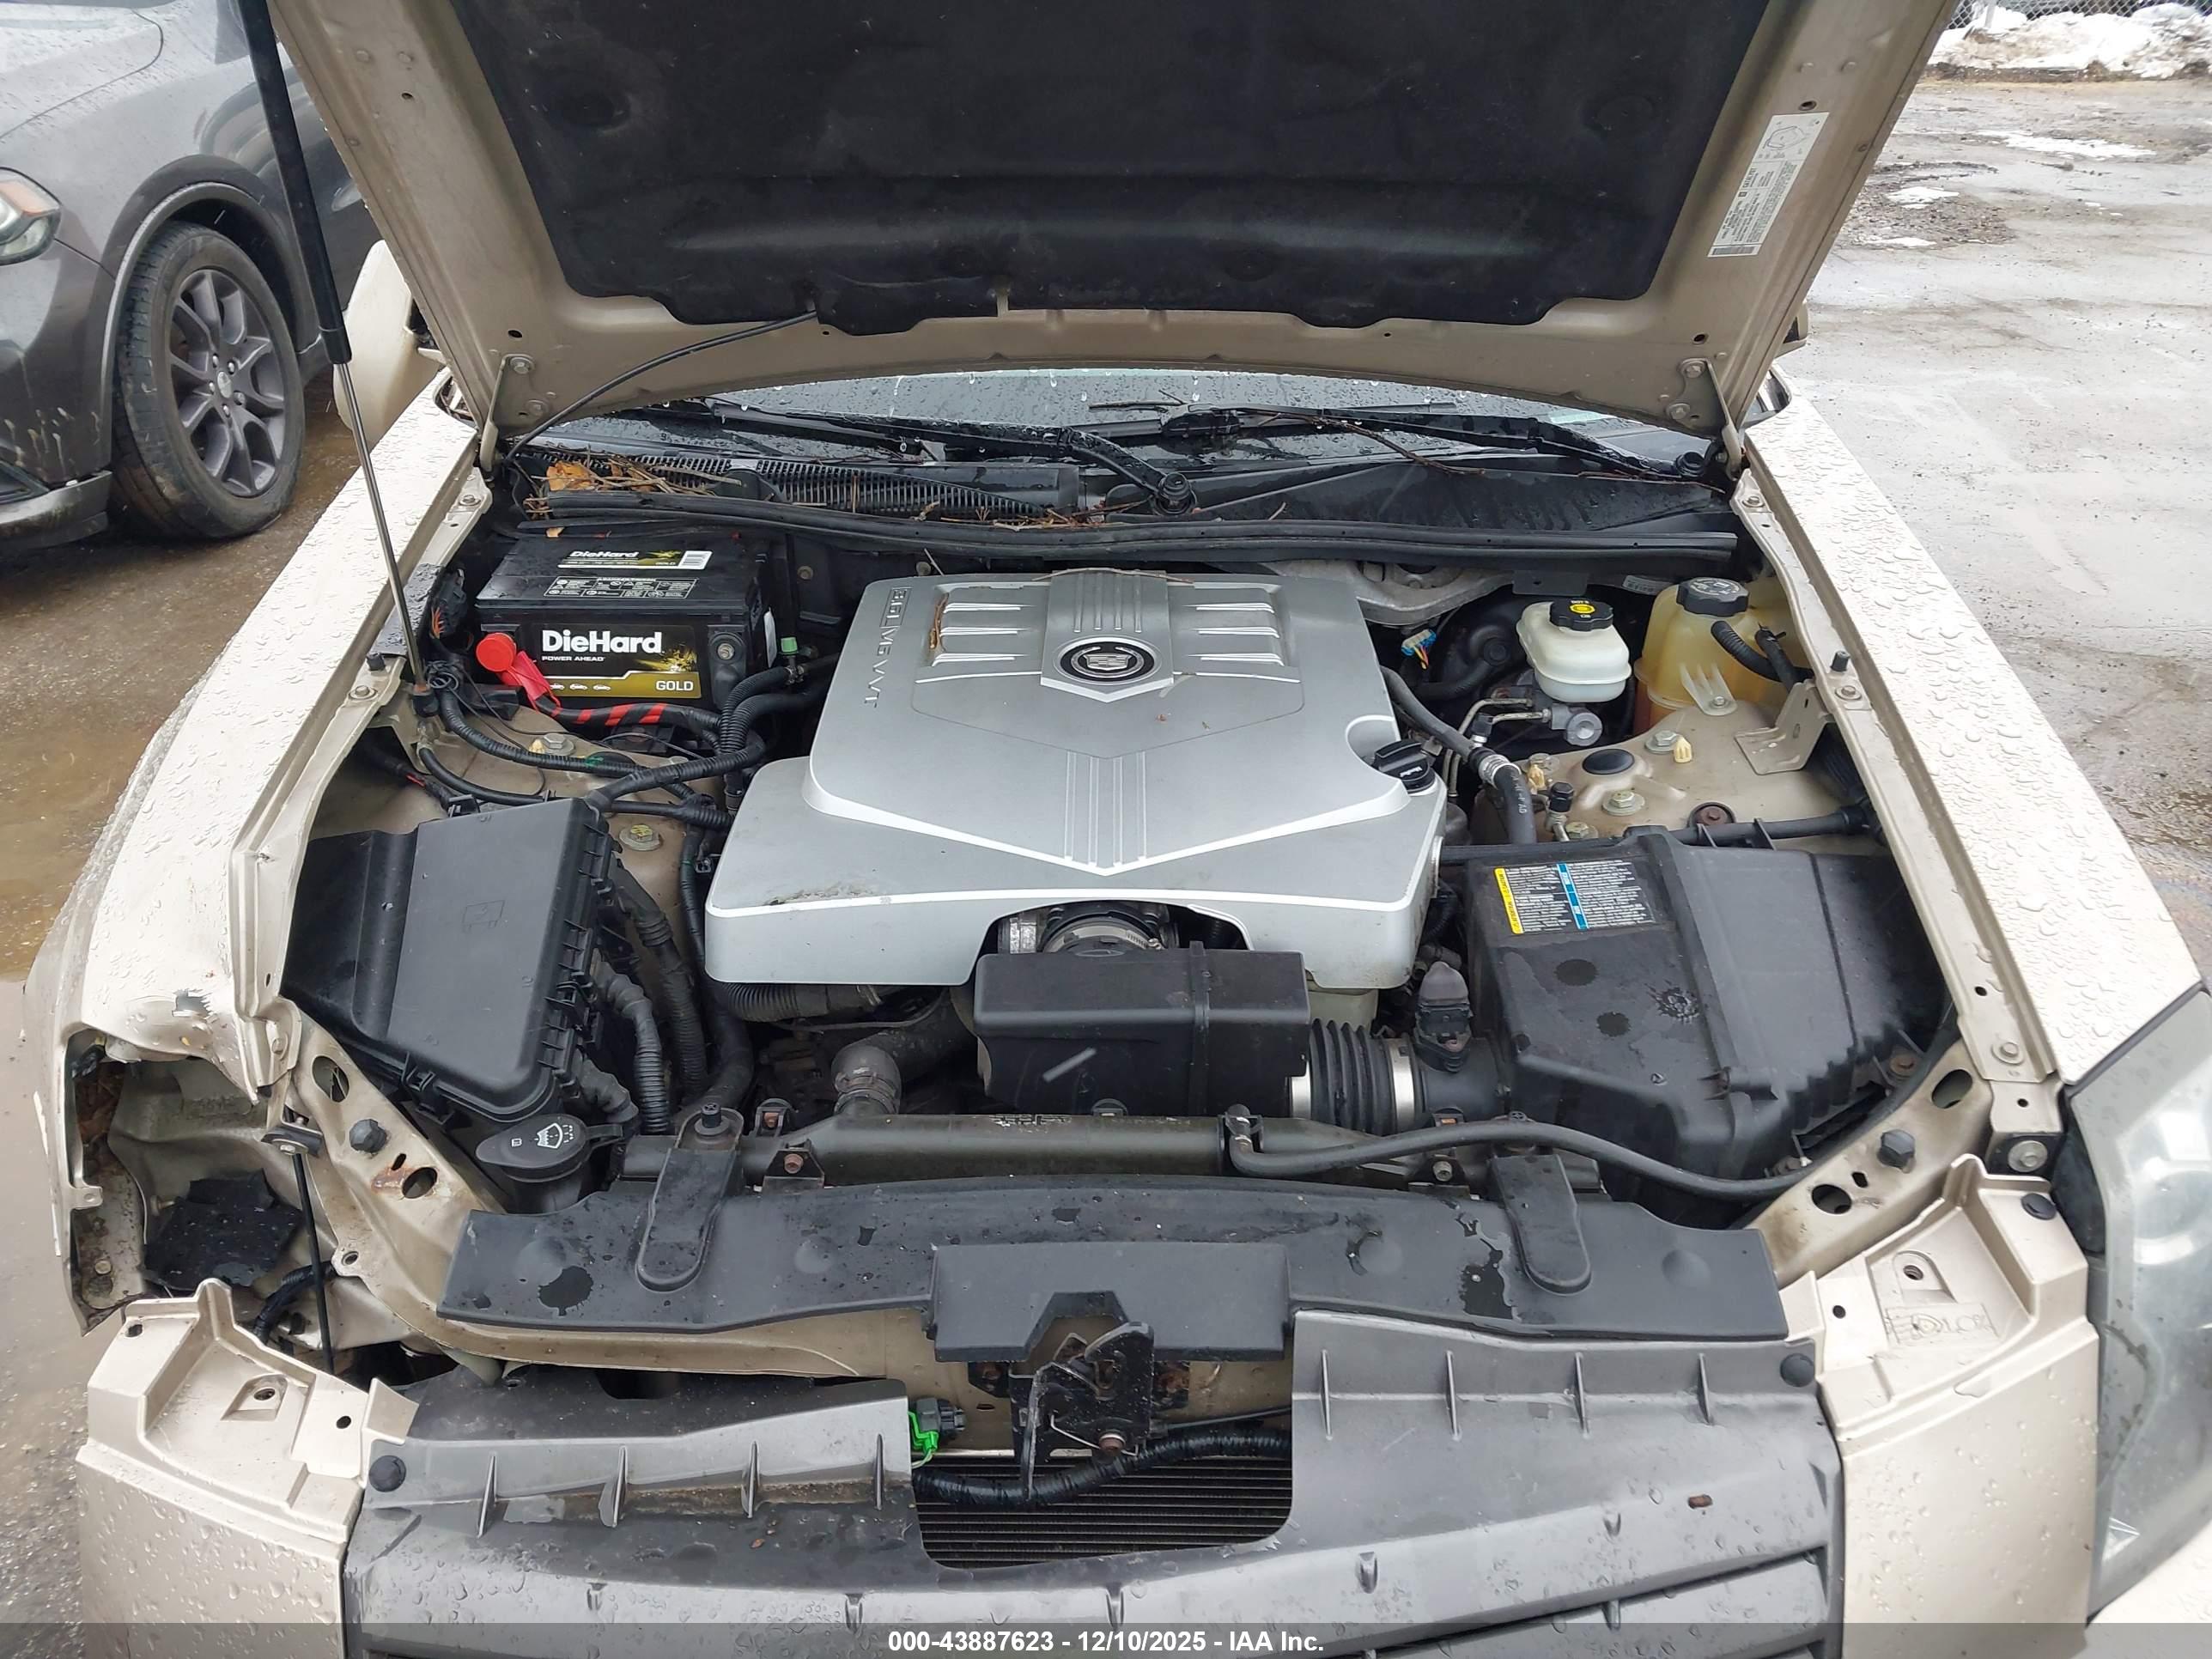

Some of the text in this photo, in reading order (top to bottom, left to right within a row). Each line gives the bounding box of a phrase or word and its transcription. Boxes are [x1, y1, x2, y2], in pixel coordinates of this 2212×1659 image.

[542, 629, 662, 653] DieHard
[655, 680, 694, 692] GOLD
[865, 659, 887, 708] VVT
